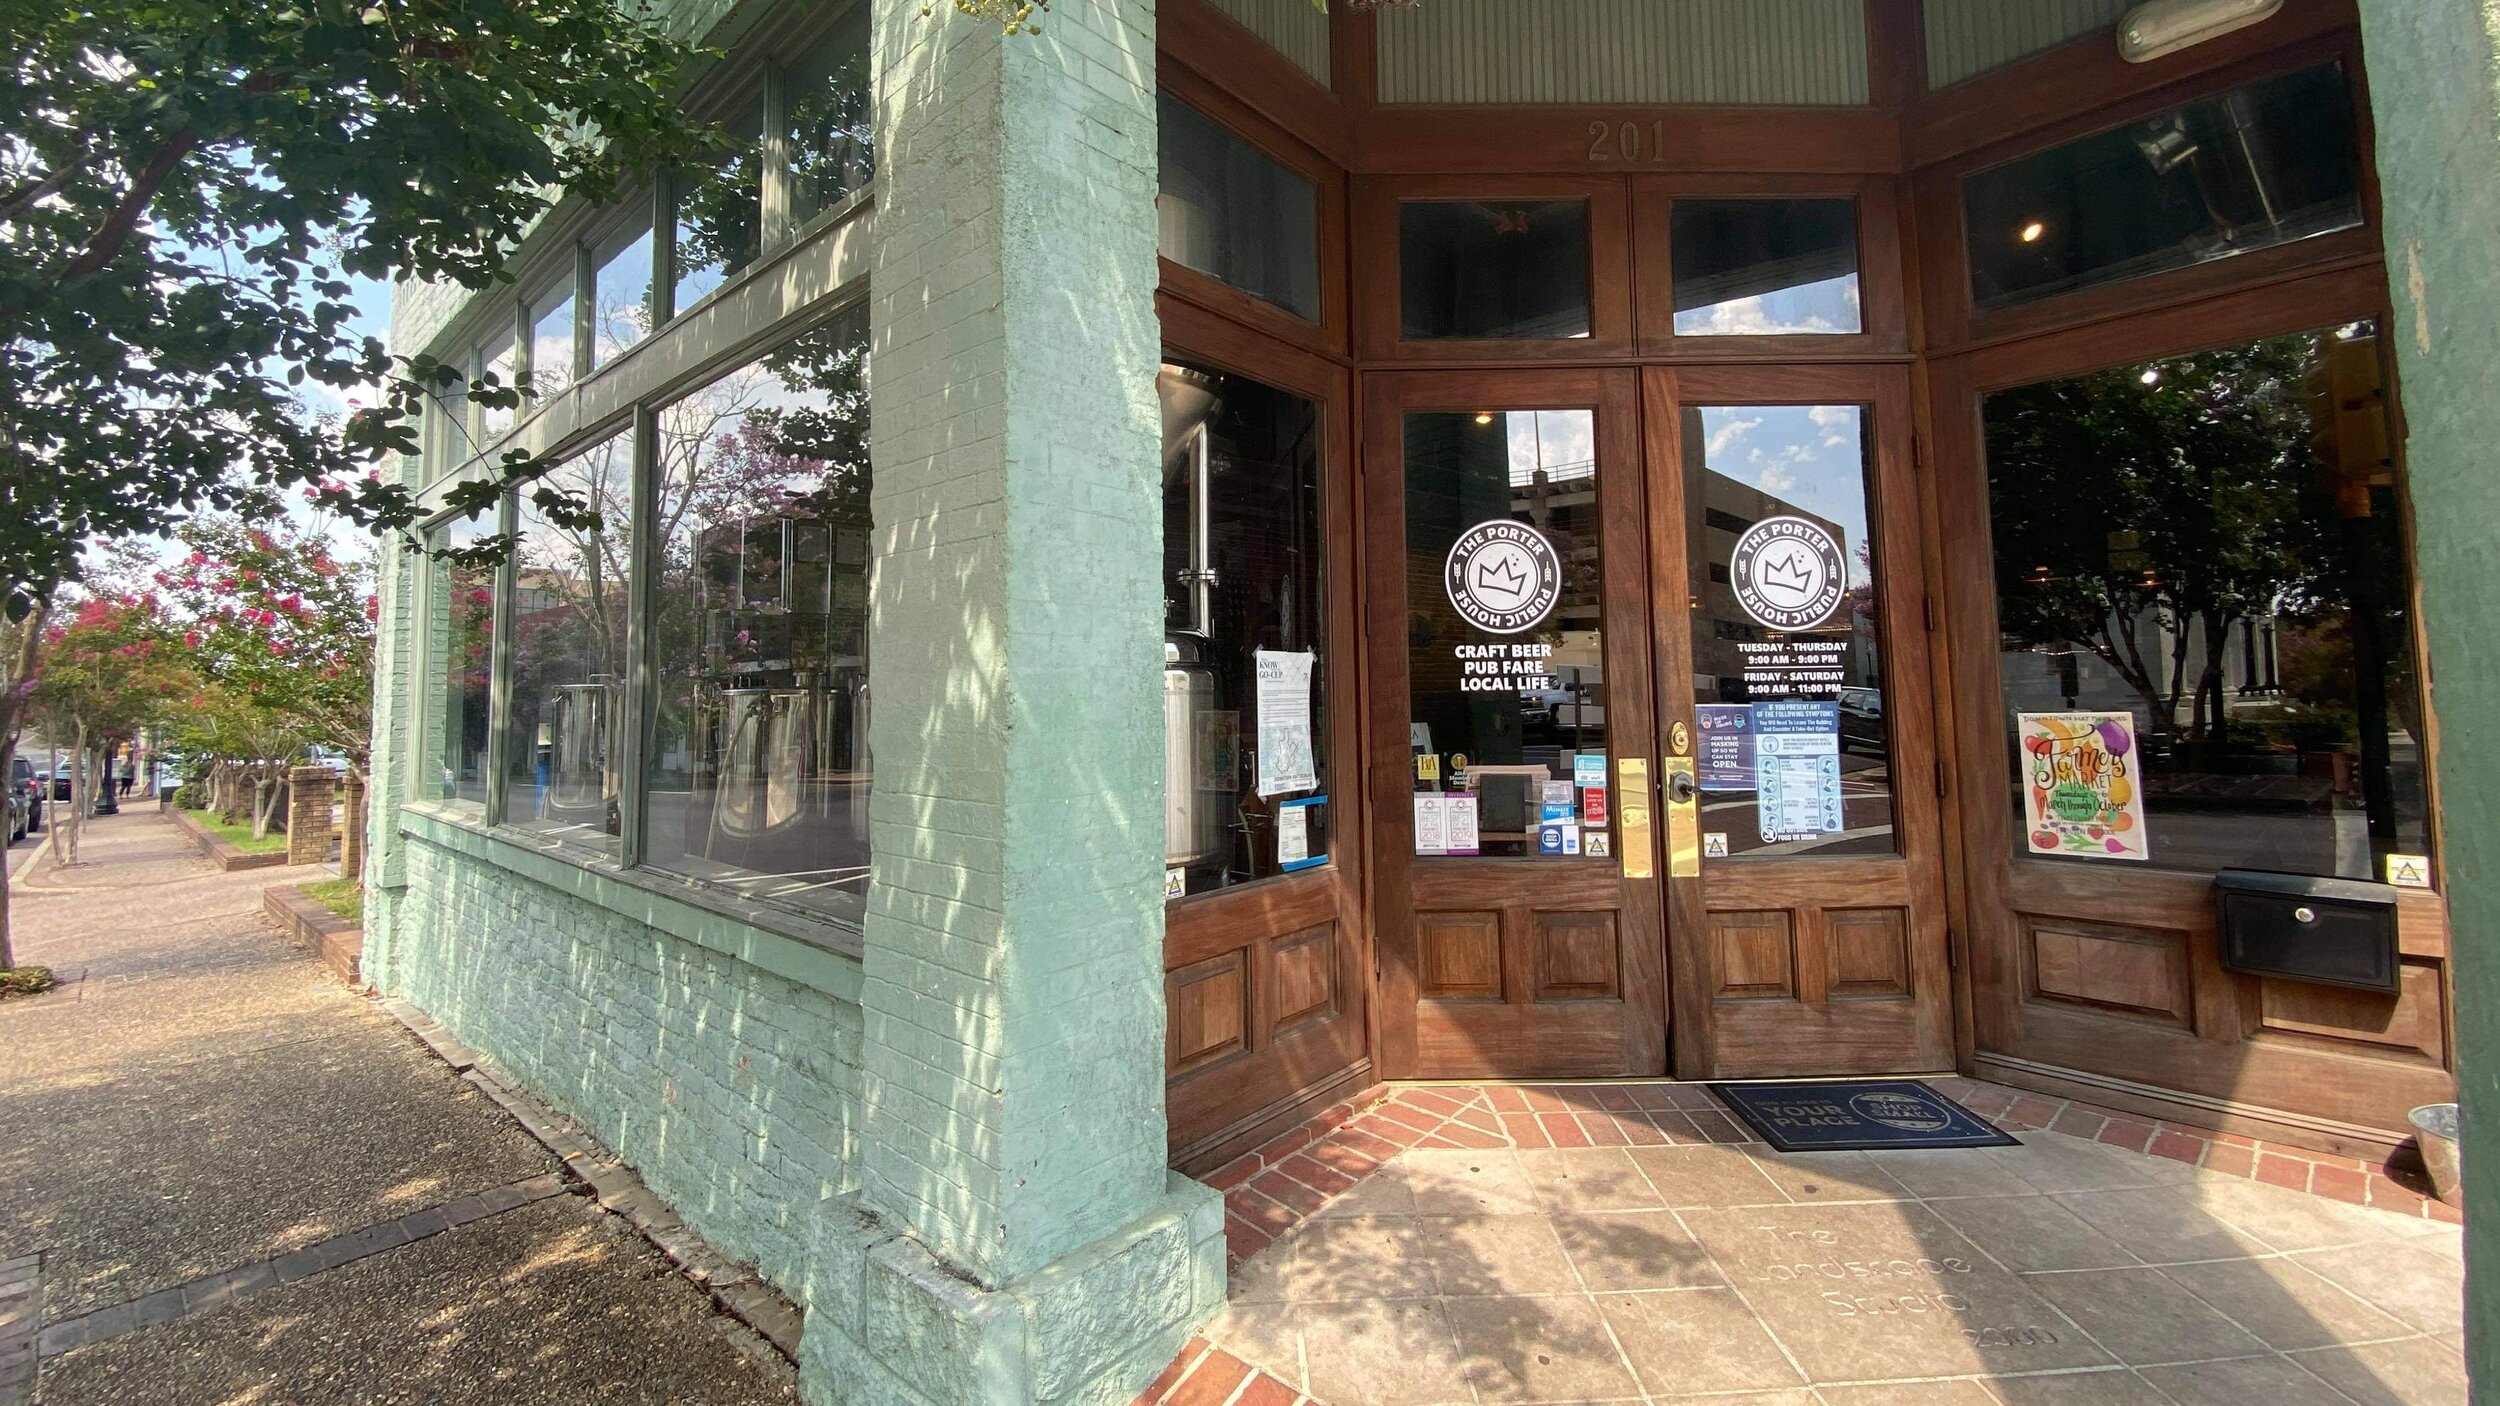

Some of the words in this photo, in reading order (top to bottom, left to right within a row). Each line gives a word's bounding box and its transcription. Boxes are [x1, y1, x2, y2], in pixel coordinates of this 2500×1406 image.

[1587, 119, 1665, 163] 201
[1456, 532, 1485, 557] THE
[1486, 526, 1544, 556] PORTER
[1742, 528, 1770, 554] THE
[1771, 523, 1829, 553] PORTER
[1454, 589, 1501, 627] HOUSE
[1505, 588, 1552, 627] PUBLIC
[1741, 586, 1787, 624] HOUSE
[1792, 585, 1838, 624] PUBLIC
[1454, 644, 1508, 659] CRAFT
[1511, 643, 1552, 658] BEER
[1737, 643, 1784, 652] TUESDAY
[1792, 642, 1848, 652] THURSDAY
[1748, 655, 1770, 664] 9:00
[1772, 654, 1790, 664] AM
[1798, 654, 1820, 664] 9:00
[1821, 654, 1838, 664] PM
[1464, 661, 1499, 675] PUB
[1502, 660, 1544, 674] FARE
[1460, 677, 1513, 692] LOCAL
[1516, 676, 1550, 690] LIFE
[1744, 672, 1781, 682] FRIDAY
[1790, 672, 1844, 681] SATURDAY
[1748, 684, 1770, 694] 9:00
[1772, 684, 1790, 693] AM
[1798, 684, 1823, 693] 11:00
[1824, 684, 1842, 692] PM
[2034, 724, 2126, 790] Farmers
[2060, 770, 2112, 790] MARKET
[2040, 795, 2066, 812] March
[2093, 797, 2127, 812] October
[1762, 1104, 1848, 1118] YOUR
[1870, 1102, 1922, 1112] SHOP
[1872, 1110, 1938, 1120] SMALL
[1772, 1115, 1861, 1128] PLACE
[1758, 1224, 1839, 1245] The
